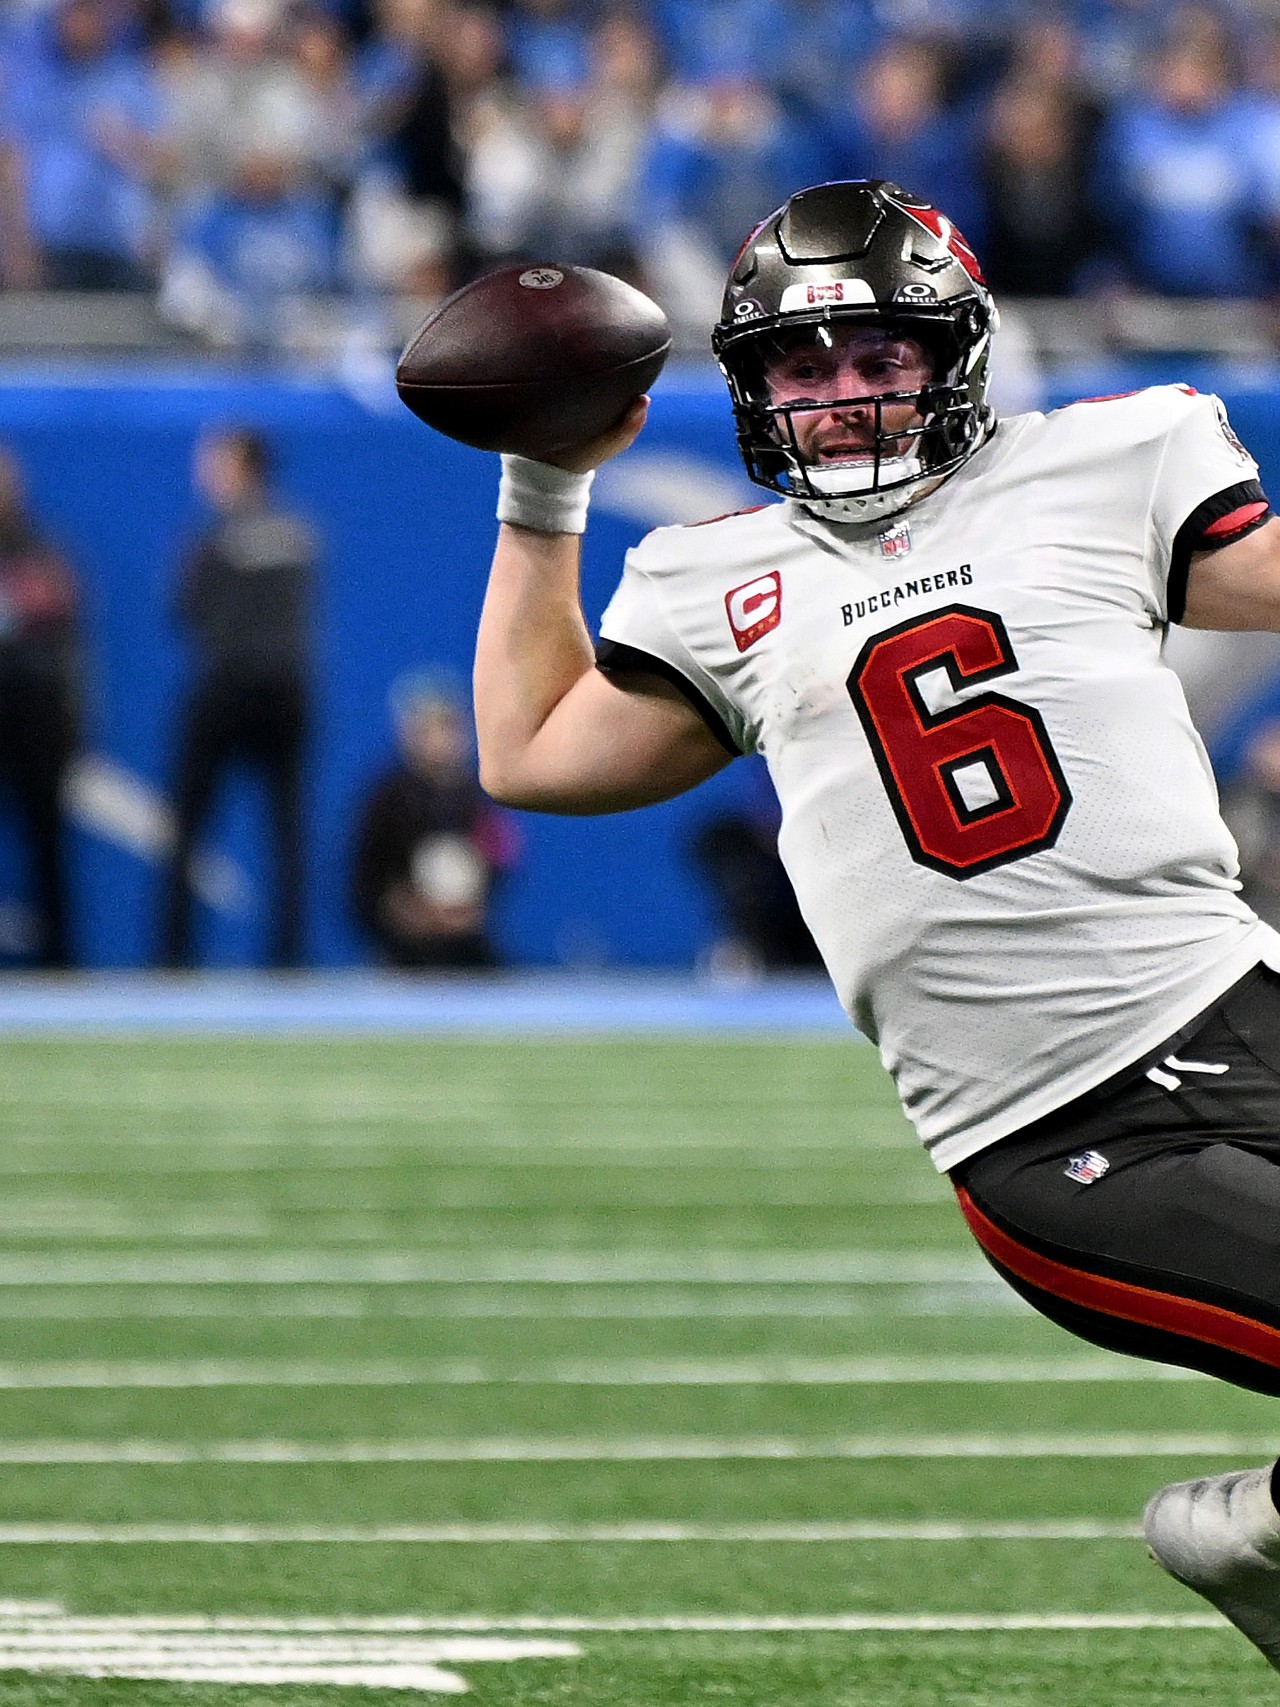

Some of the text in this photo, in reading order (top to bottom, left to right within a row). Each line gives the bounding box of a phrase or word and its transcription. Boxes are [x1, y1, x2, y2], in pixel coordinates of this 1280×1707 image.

[730, 577, 778, 632] C
[841, 564, 973, 627] BUCCANEERS
[846, 603, 1073, 882] 6
